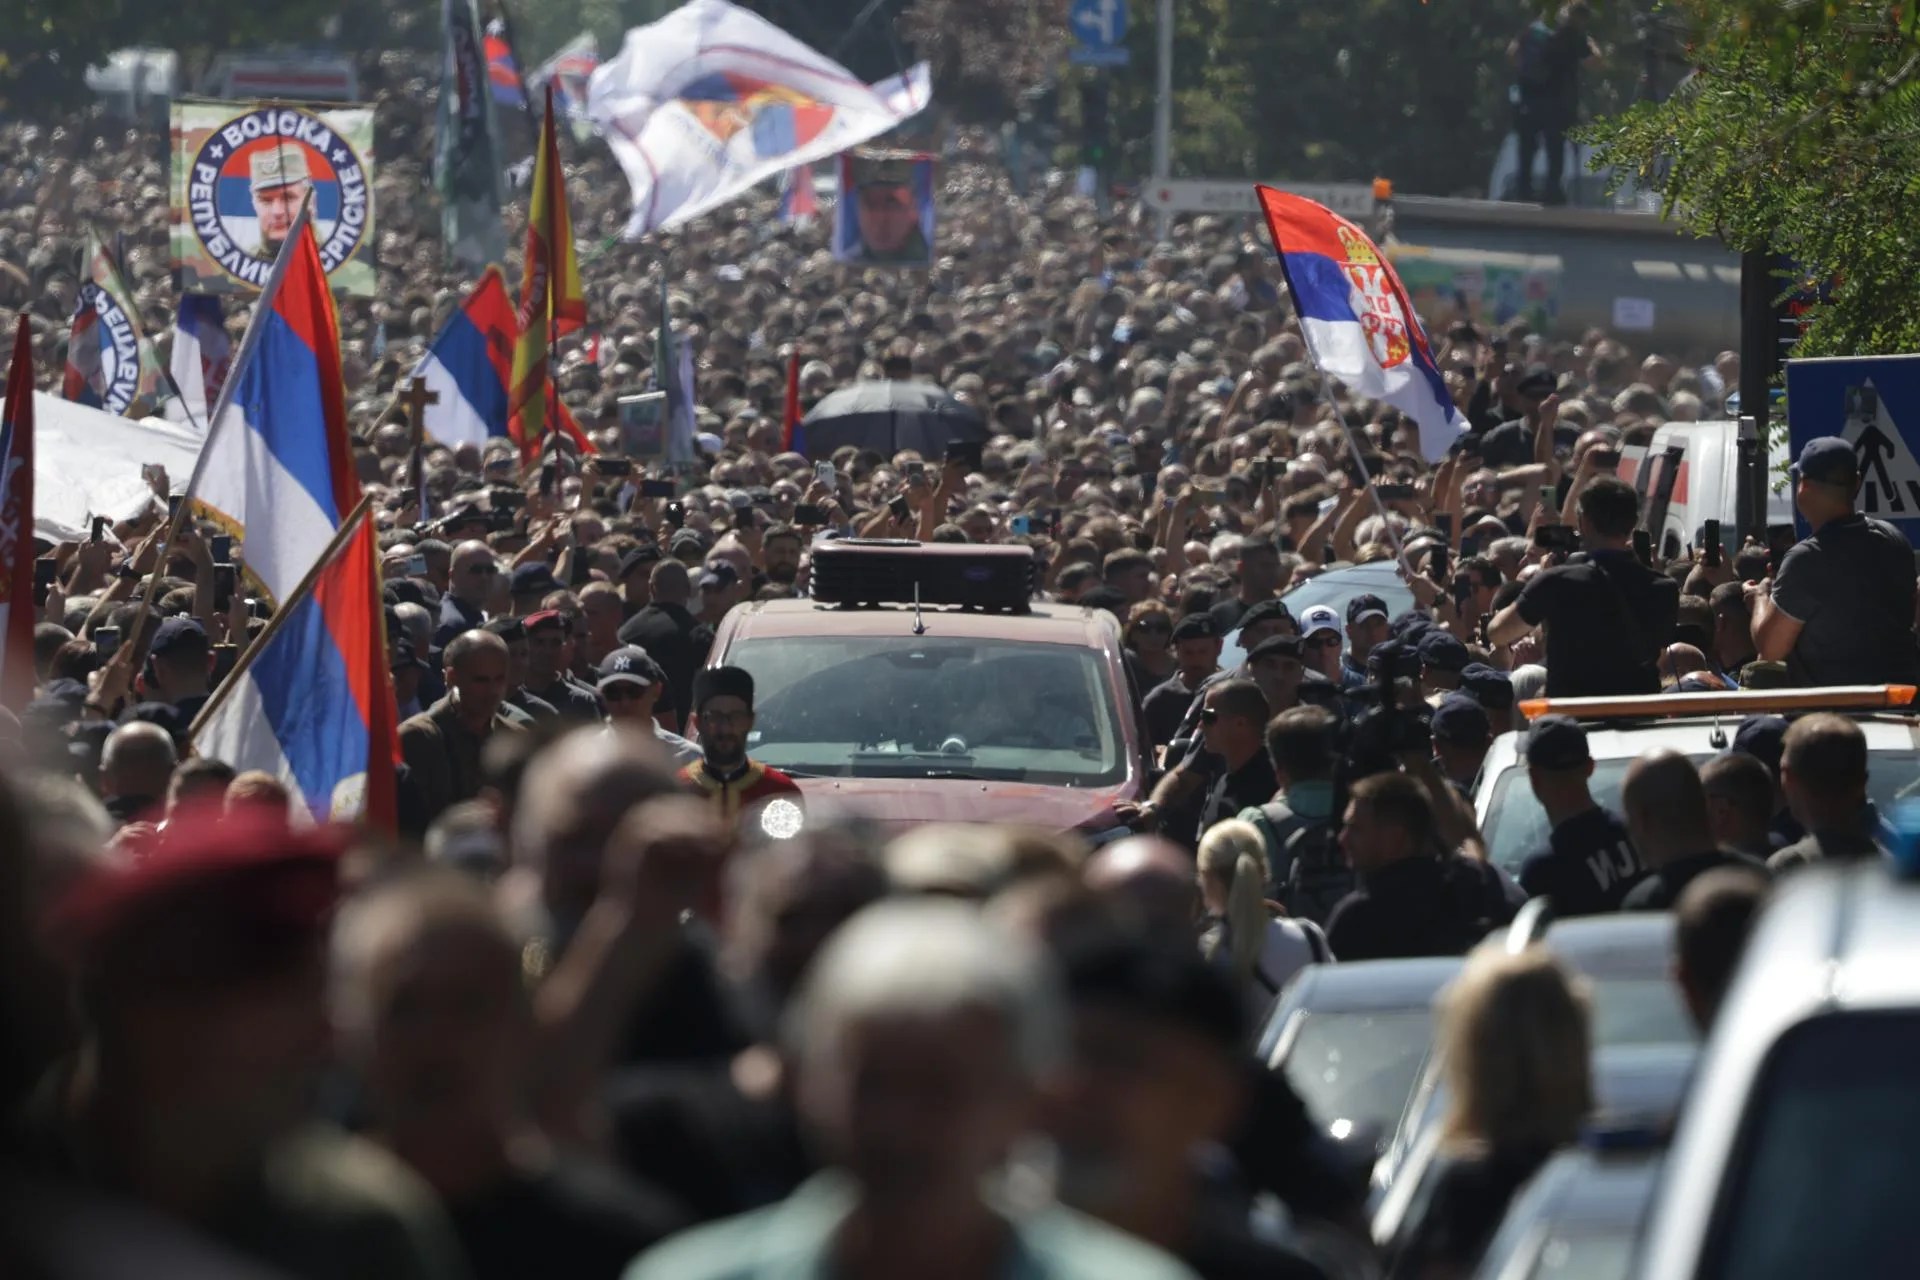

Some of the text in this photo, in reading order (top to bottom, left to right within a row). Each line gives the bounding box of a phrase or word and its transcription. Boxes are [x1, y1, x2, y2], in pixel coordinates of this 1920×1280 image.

[222, 111, 332, 152] ВОЈСКА
[191, 162, 275, 287] РЕПУБЛИК
[614, 655, 631, 670] NY
